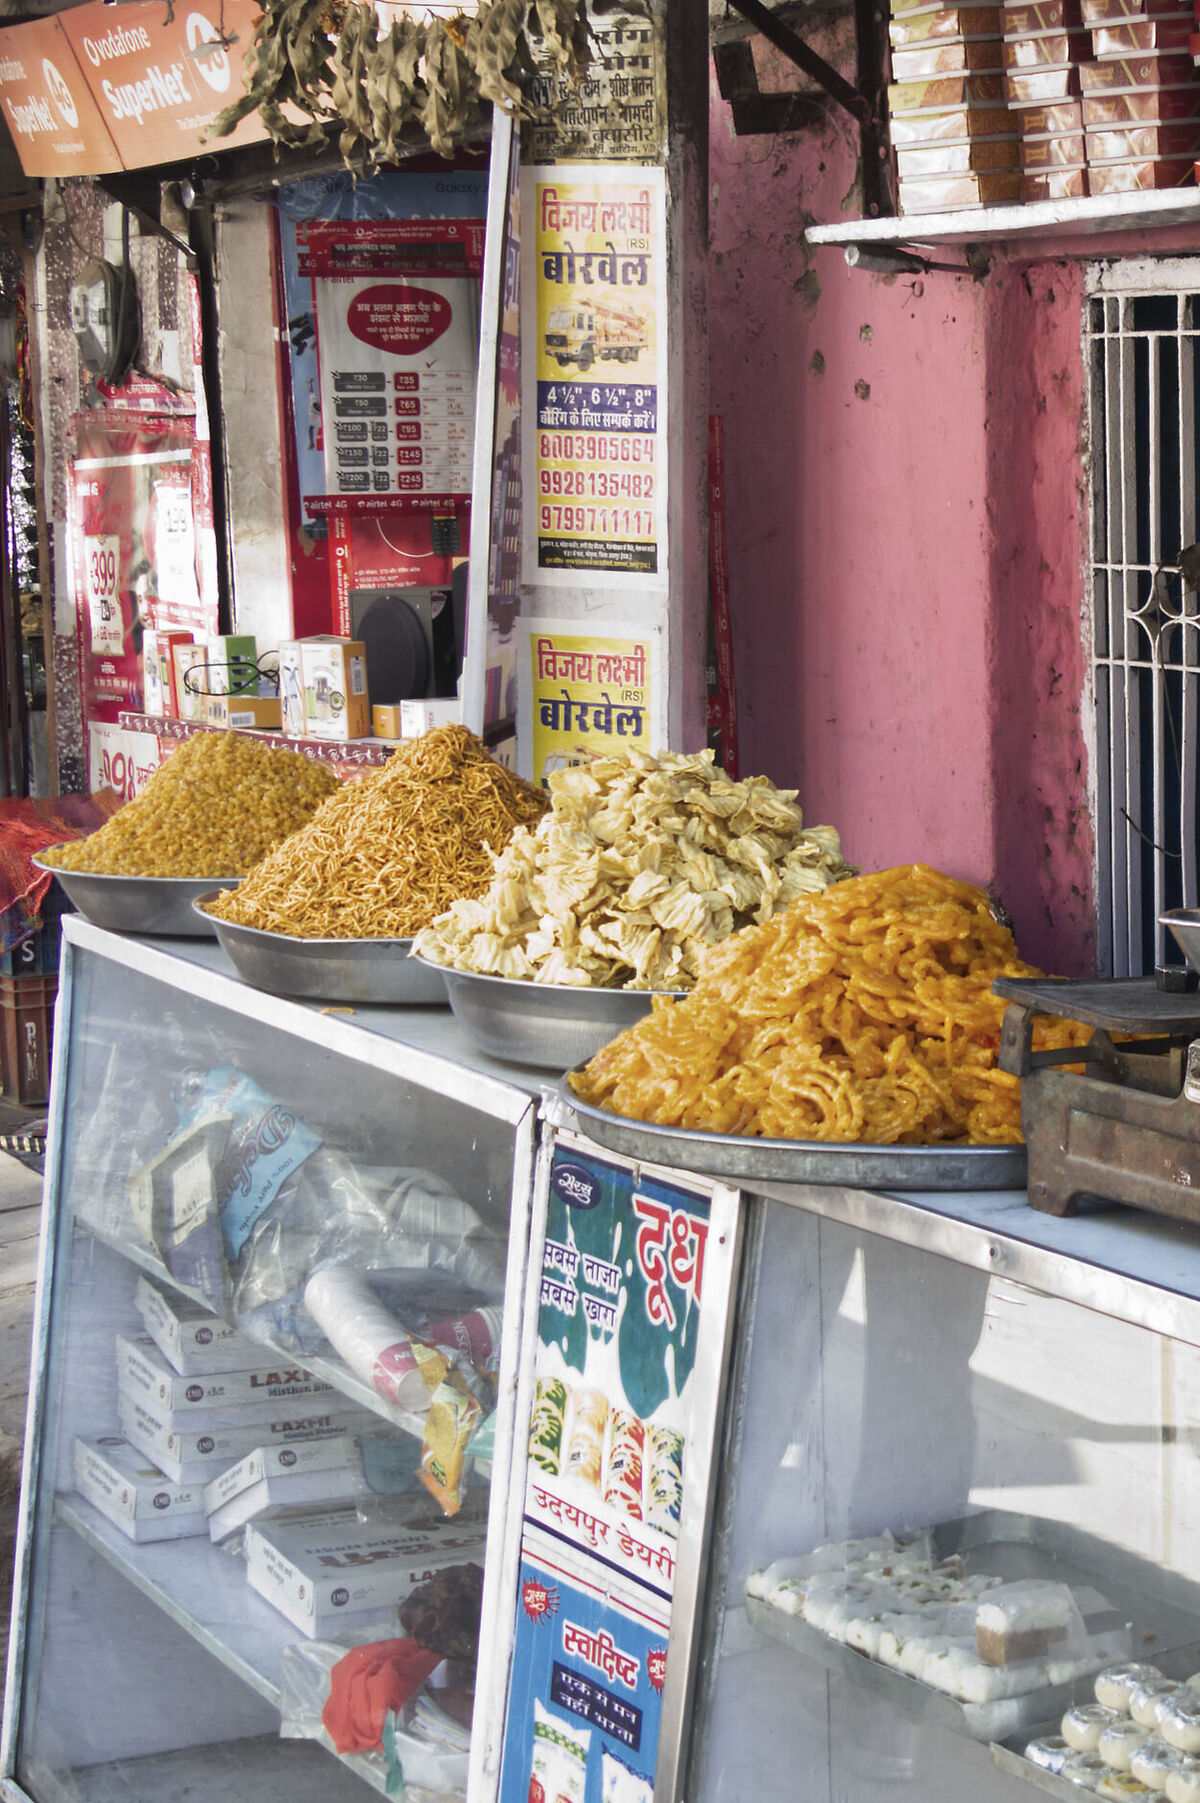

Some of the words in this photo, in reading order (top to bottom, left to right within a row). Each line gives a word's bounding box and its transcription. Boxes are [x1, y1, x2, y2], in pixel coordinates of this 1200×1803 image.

[102, 65, 192, 125] SuperNet
[542, 188, 597, 232] विजय
[601, 190, 651, 234] लक्ष्मी
[626, 238, 649, 250] (RS)
[542, 241, 651, 286] बोरवेल
[548, 386, 557, 402] 4
[591, 387, 600, 404] 6
[569, 408, 579, 425] के
[581, 408, 601, 426] लिए
[540, 434, 654, 462] 8003905664
[541, 470, 653, 498] 9928135482
[335, 500, 347, 509] 4G
[390, 500, 402, 508] 4G
[541, 506, 653, 535] 9799711117
[92, 551, 116, 595] 399
[537, 639, 592, 683] विजय
[597, 645, 646, 688] लक्ष्मी
[538, 689, 646, 737] बोरवेल
[621, 690, 644, 702] (RS)
[634, 1197, 709, 1327] दूध
[270, 1416, 331, 1434] LAXMI
[532, 1484, 611, 1547] उदयपुर
[616, 1523, 676, 1580] डेयरी
[565, 1624, 639, 1688] स्वादिष्ट
[561, 1671, 591, 1696] एक
[614, 1701, 637, 1724] मन
